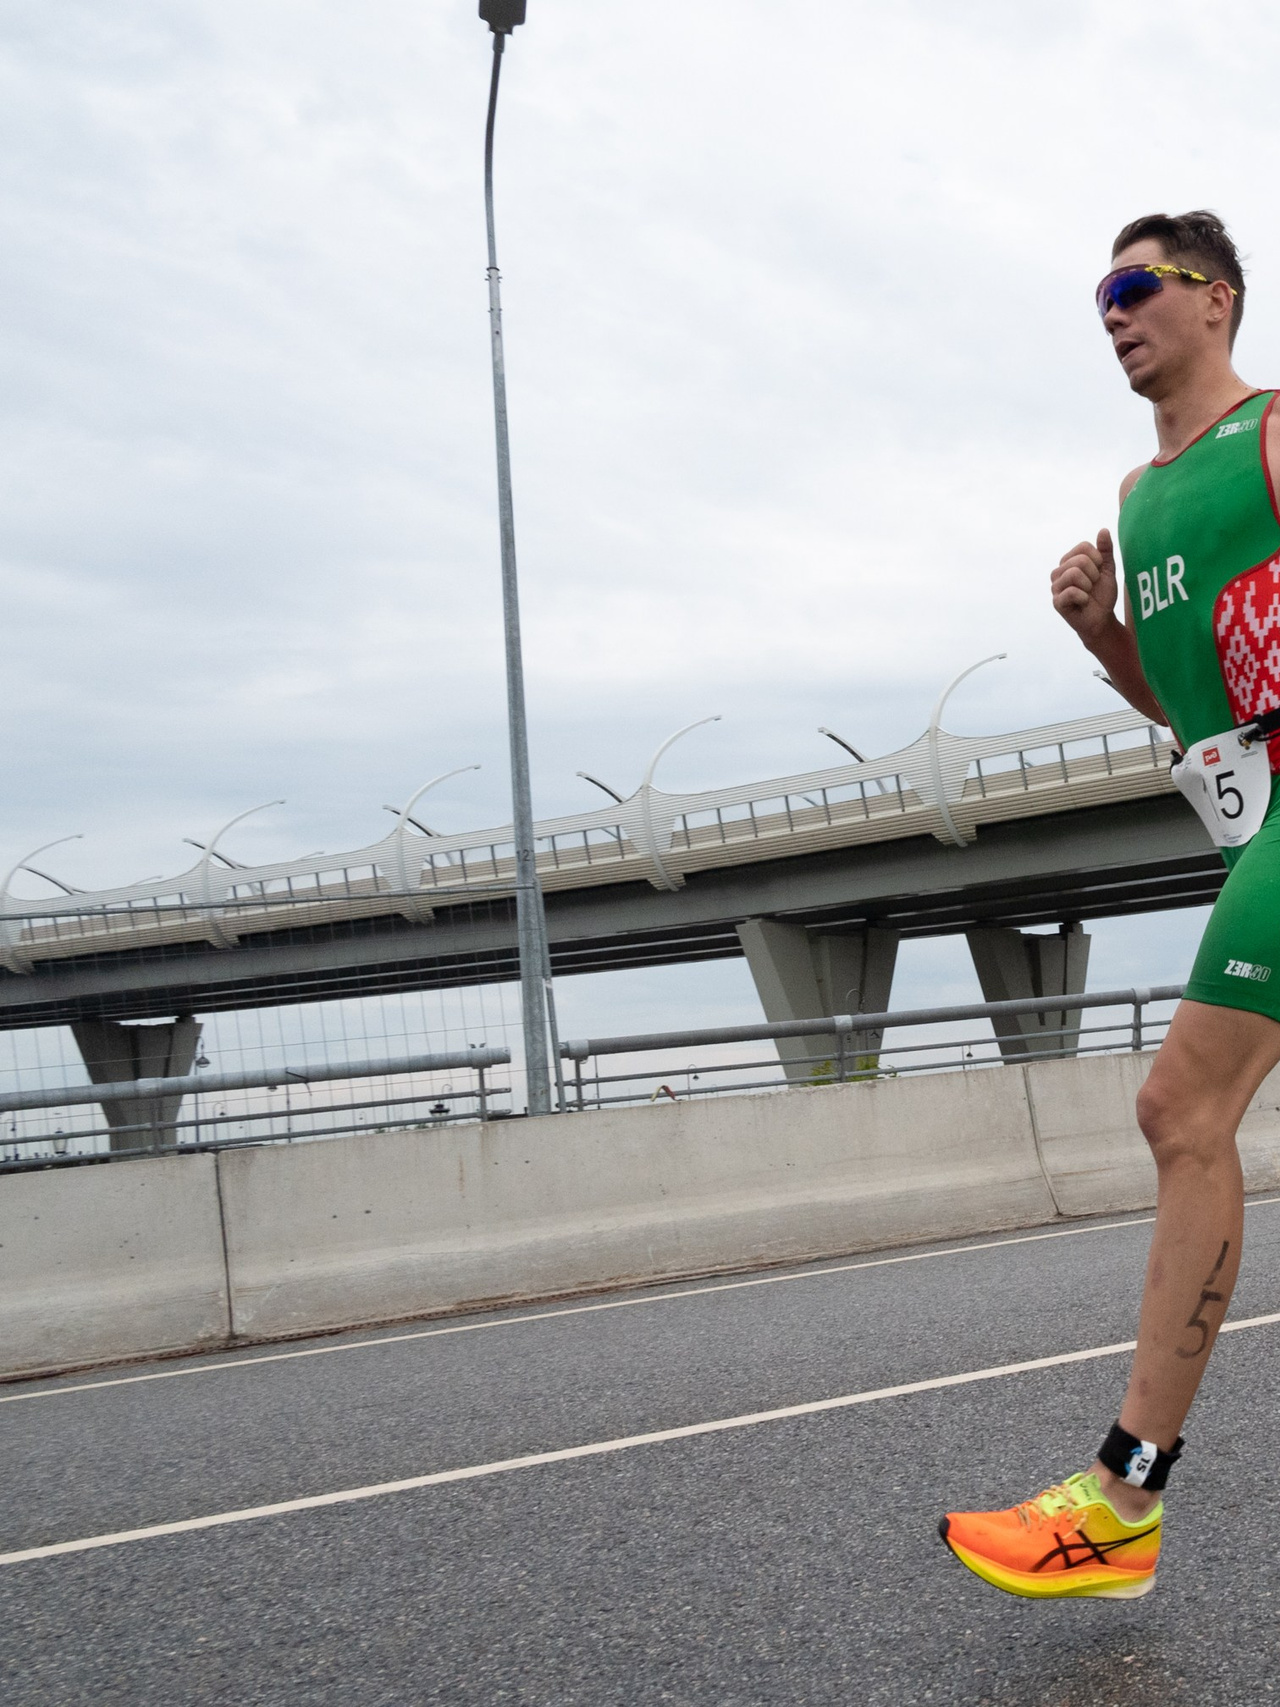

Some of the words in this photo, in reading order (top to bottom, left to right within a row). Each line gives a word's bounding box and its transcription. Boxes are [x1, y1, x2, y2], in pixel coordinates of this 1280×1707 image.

[1137, 554, 1189, 621] BLR
[1174, 1240, 1229, 1359] 15
[1136, 1457, 1151, 1473] 15
